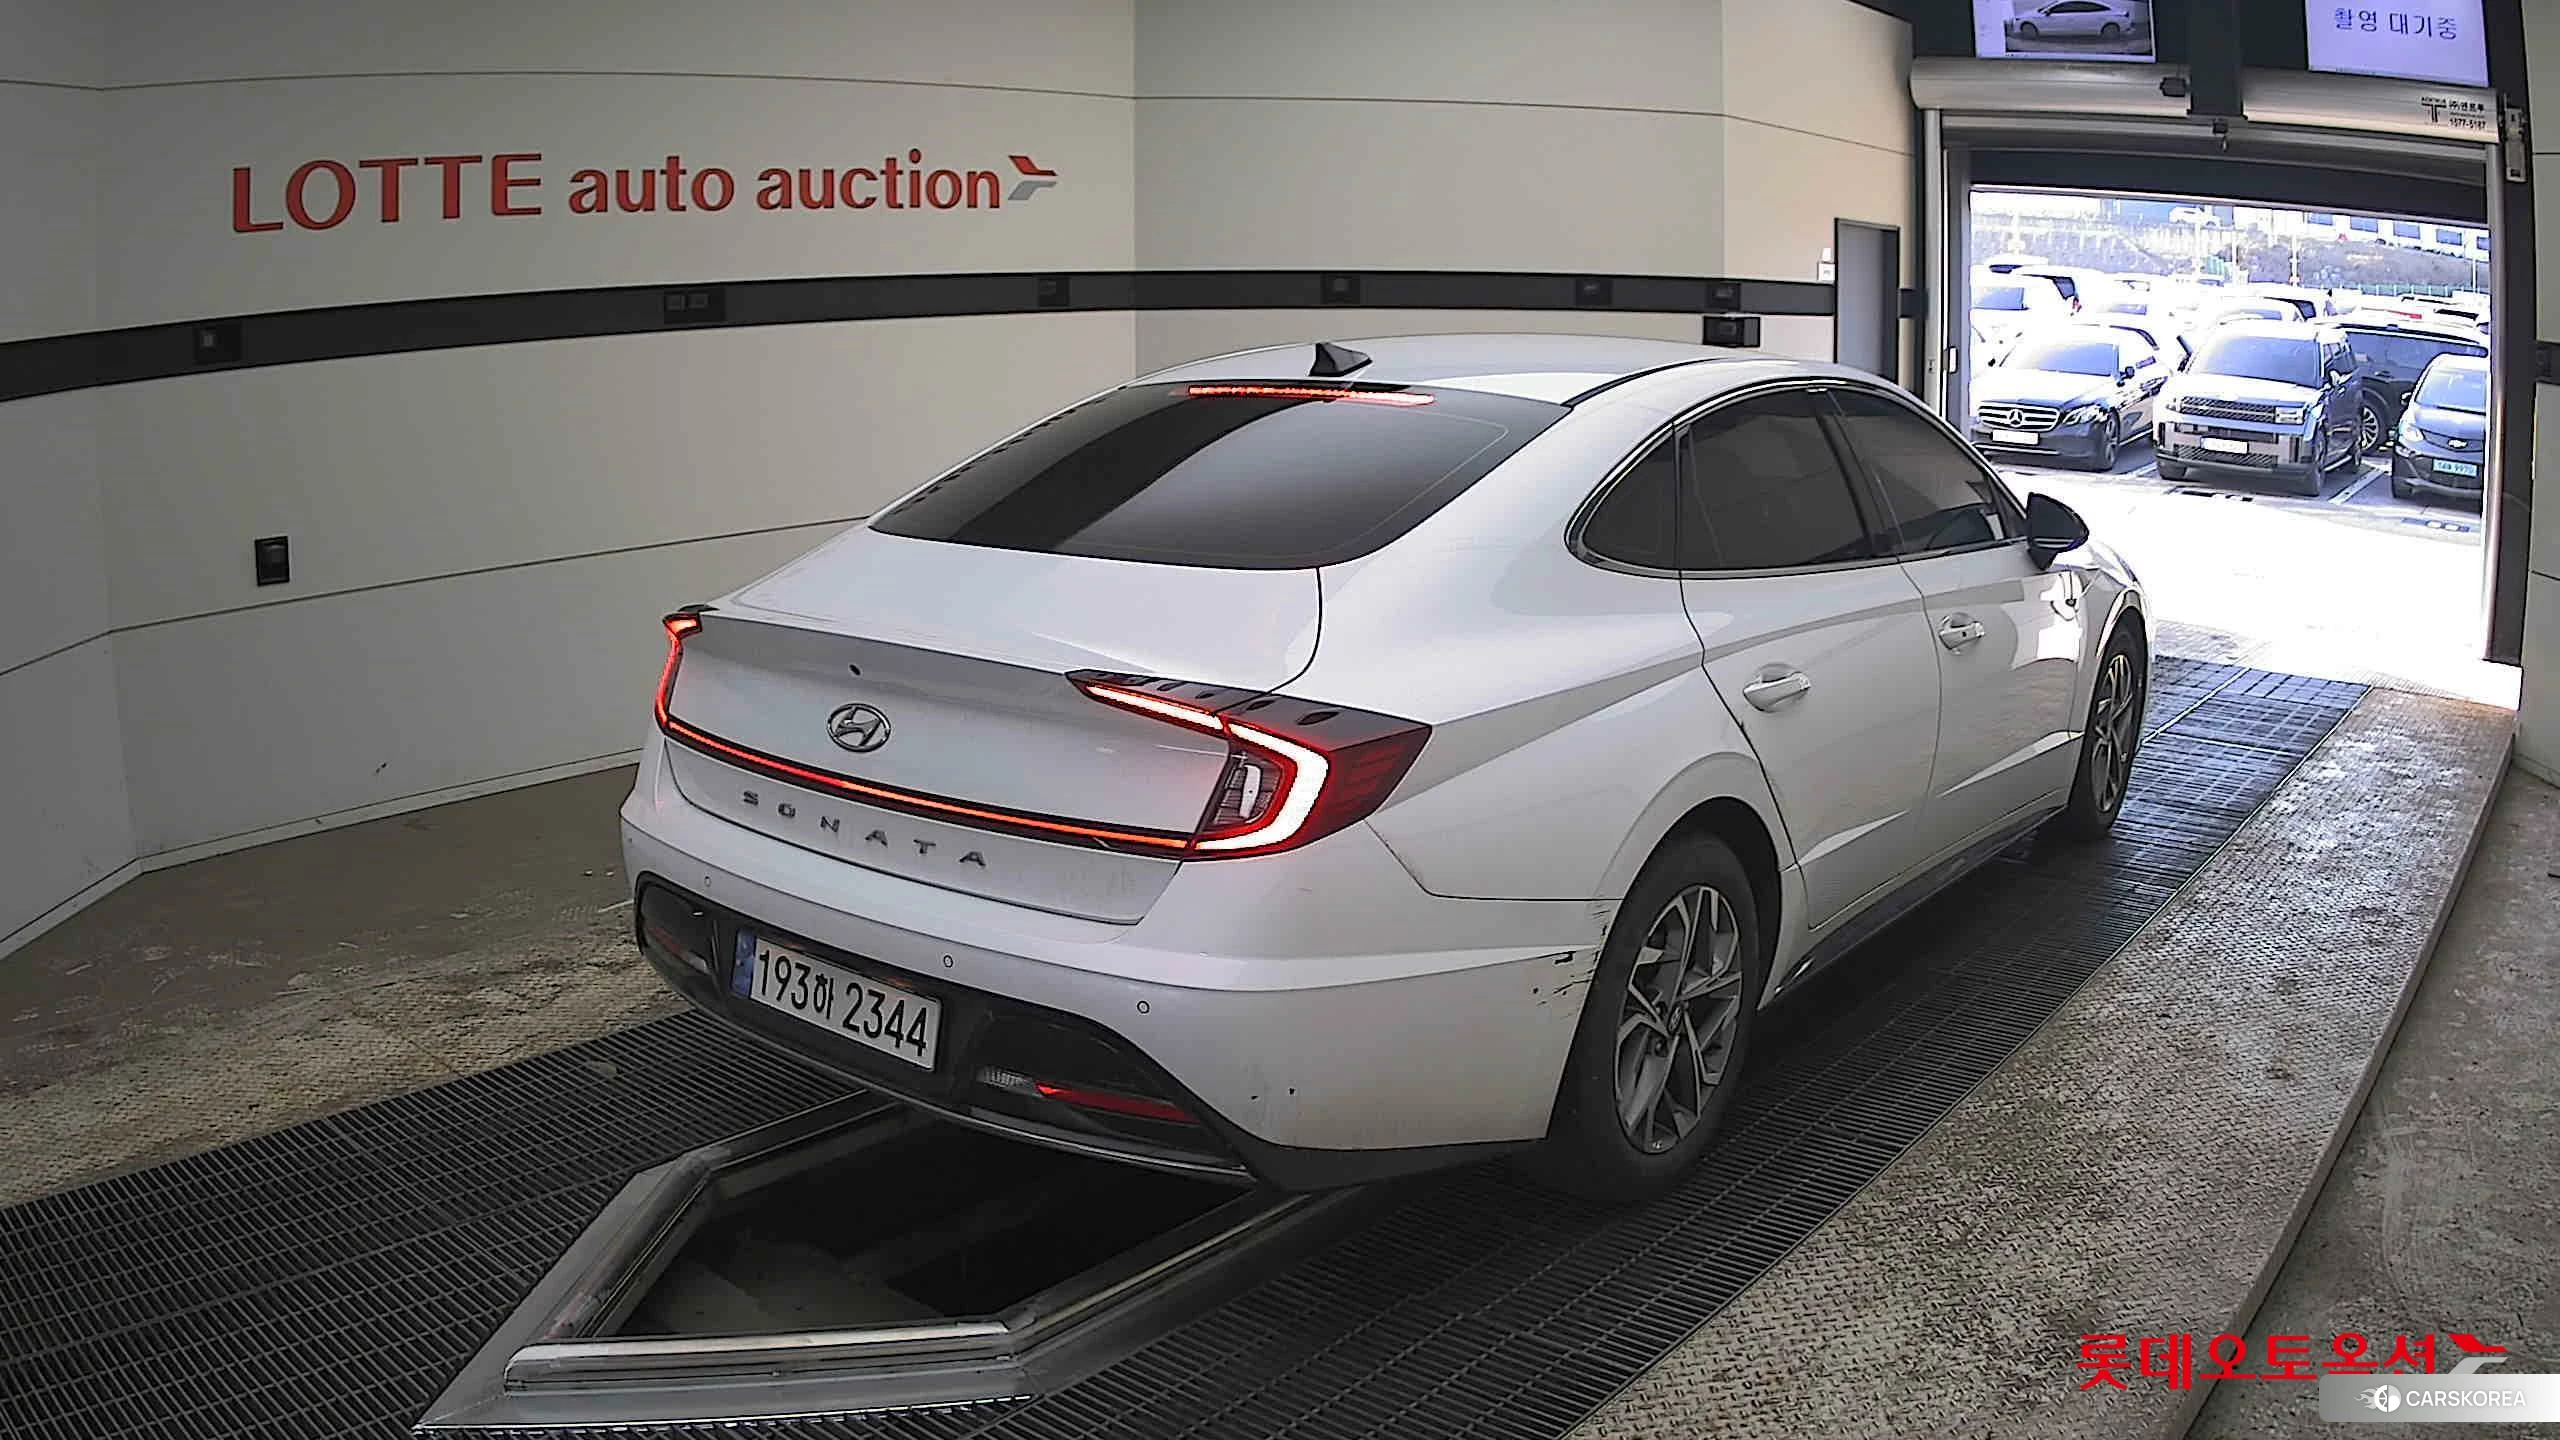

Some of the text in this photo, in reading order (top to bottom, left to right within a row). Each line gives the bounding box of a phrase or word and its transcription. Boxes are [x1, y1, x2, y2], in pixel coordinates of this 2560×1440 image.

[2335, 8, 2457, 40] 촬영 대기중
[232, 148, 1001, 233] LOTTE auto auction
[741, 790, 987, 868] SONATA
[758, 949, 928, 1058] 193하 2344
